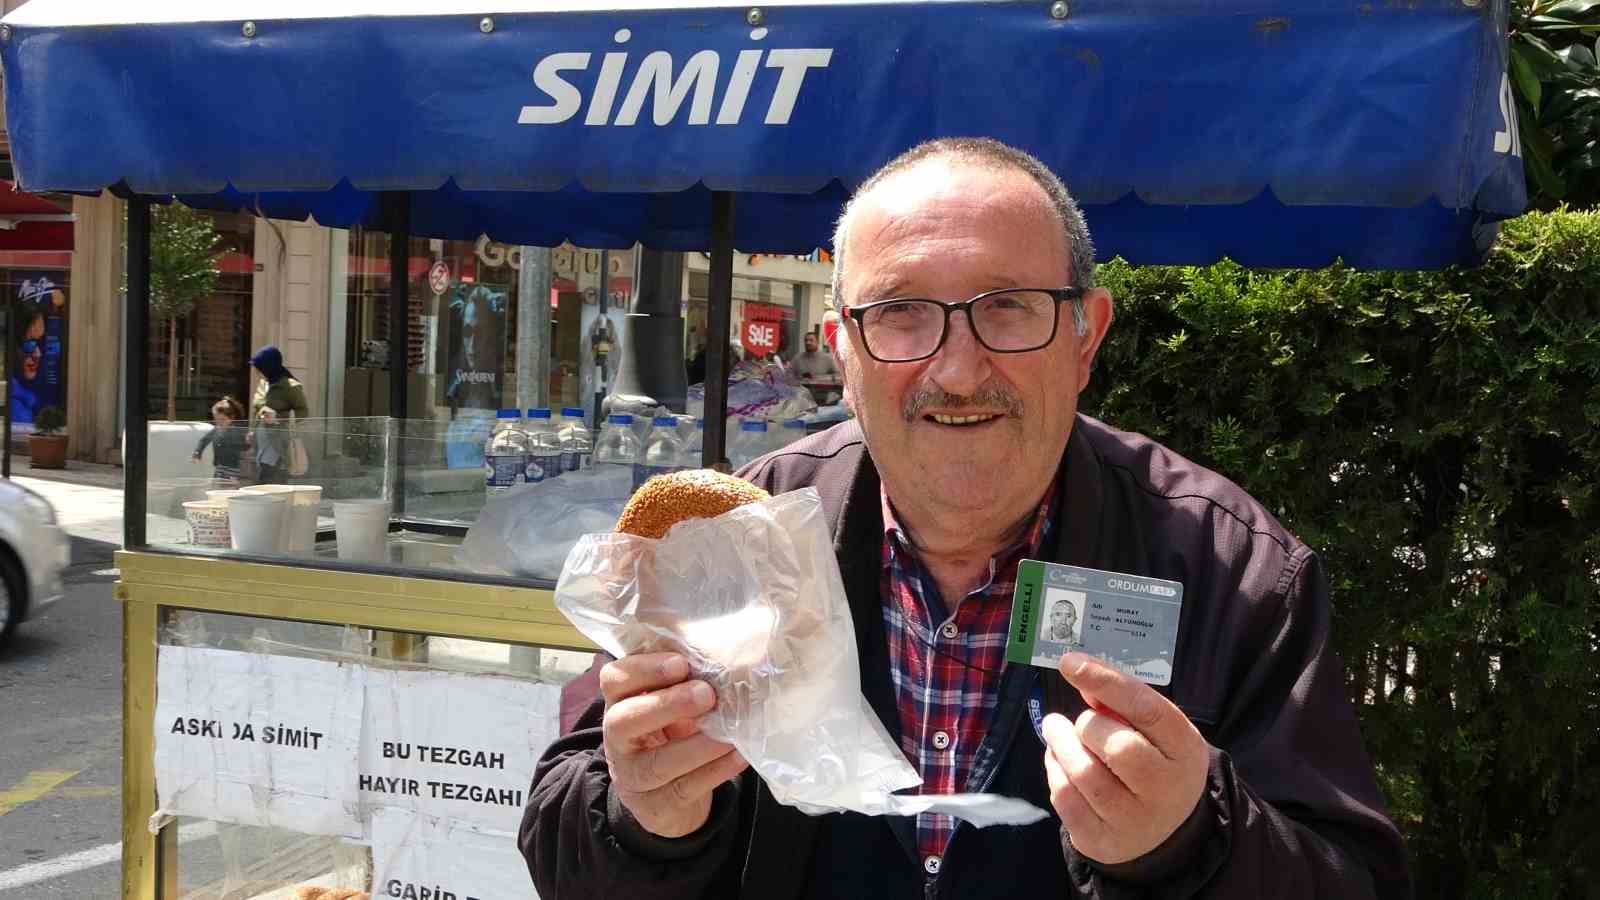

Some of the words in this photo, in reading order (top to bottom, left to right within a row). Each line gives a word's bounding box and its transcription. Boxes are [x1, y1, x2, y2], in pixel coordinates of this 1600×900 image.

[517, 28, 834, 126] SİMİT
[261, 723, 323, 750] SİMİT
[383, 742, 411, 760] BU
[417, 745, 505, 769] TEZGAH
[359, 774, 420, 797] HAYIR
[427, 781, 522, 807] TEZGAHI
